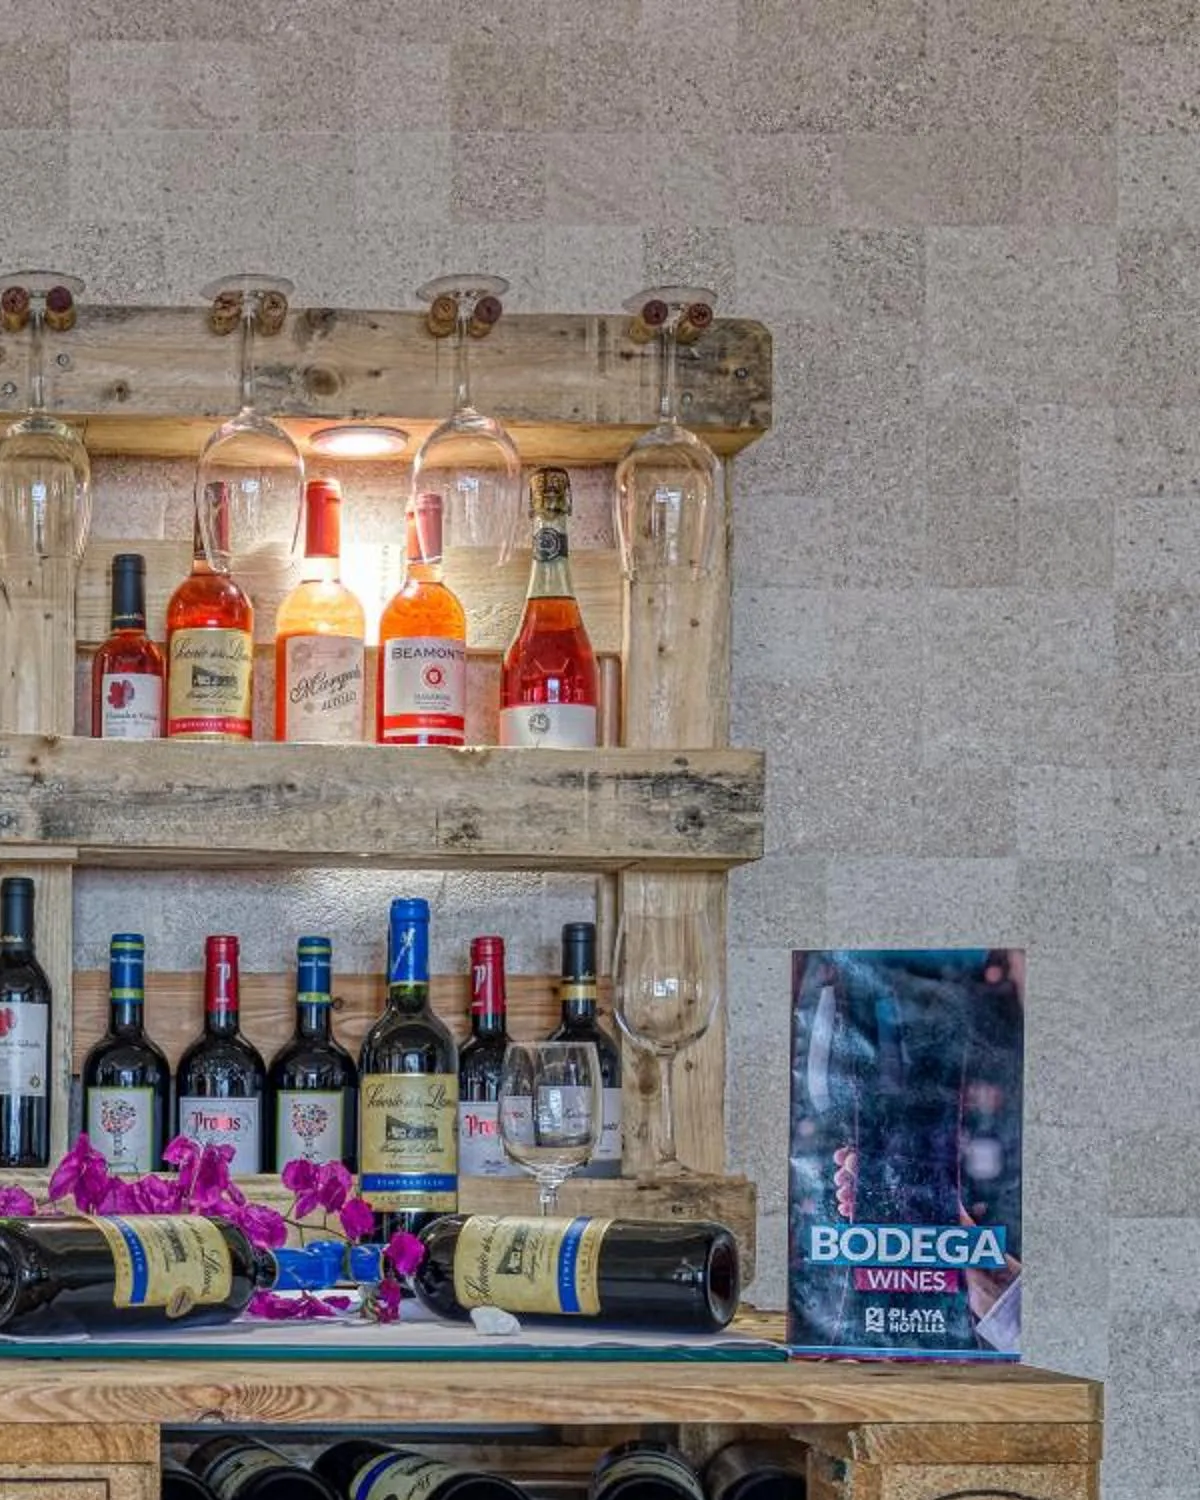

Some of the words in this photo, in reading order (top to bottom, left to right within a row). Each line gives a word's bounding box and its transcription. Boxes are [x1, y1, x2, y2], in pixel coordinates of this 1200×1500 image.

[811, 1226, 1005, 1264] BODEGA
[867, 1269, 946, 1291] WINES
[889, 1308, 945, 1322] PLAYA
[889, 1321, 946, 1333] HOTELES
